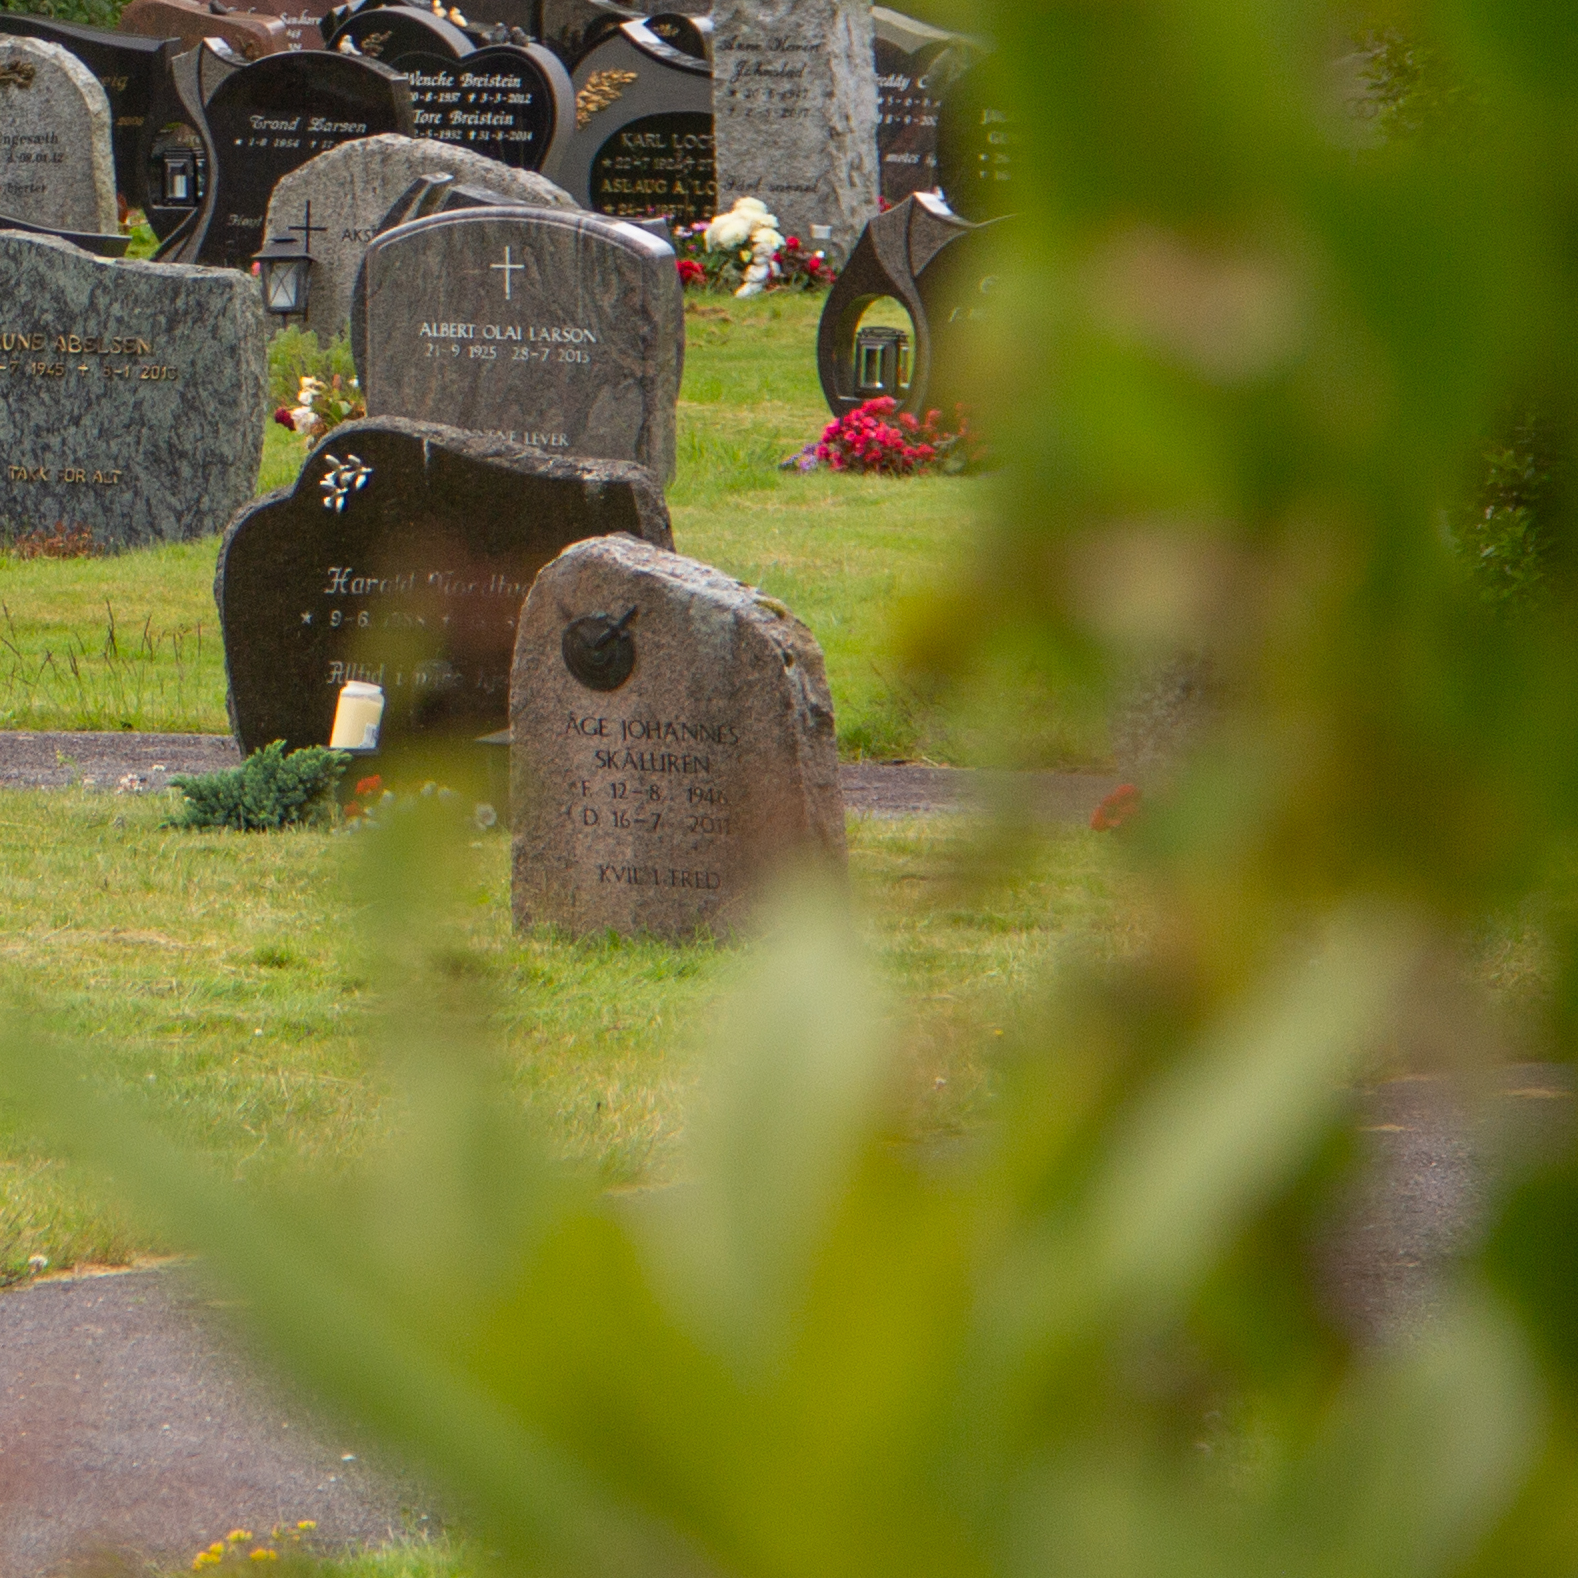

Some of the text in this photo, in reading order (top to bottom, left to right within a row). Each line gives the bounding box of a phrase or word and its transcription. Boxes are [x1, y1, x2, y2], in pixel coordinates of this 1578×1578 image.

[460, 72, 522, 88] Breistein
[249, 114, 367, 134] Trond Larsen
[449, 110, 515, 125] Breistein
[419, 322, 597, 343] ALBERT OLAI LARSON
[54, 335, 154, 356] ABELSEN
[565, 711, 739, 745] ÅGE JOHANNES
[594, 746, 710, 774] SKÅLUREN
